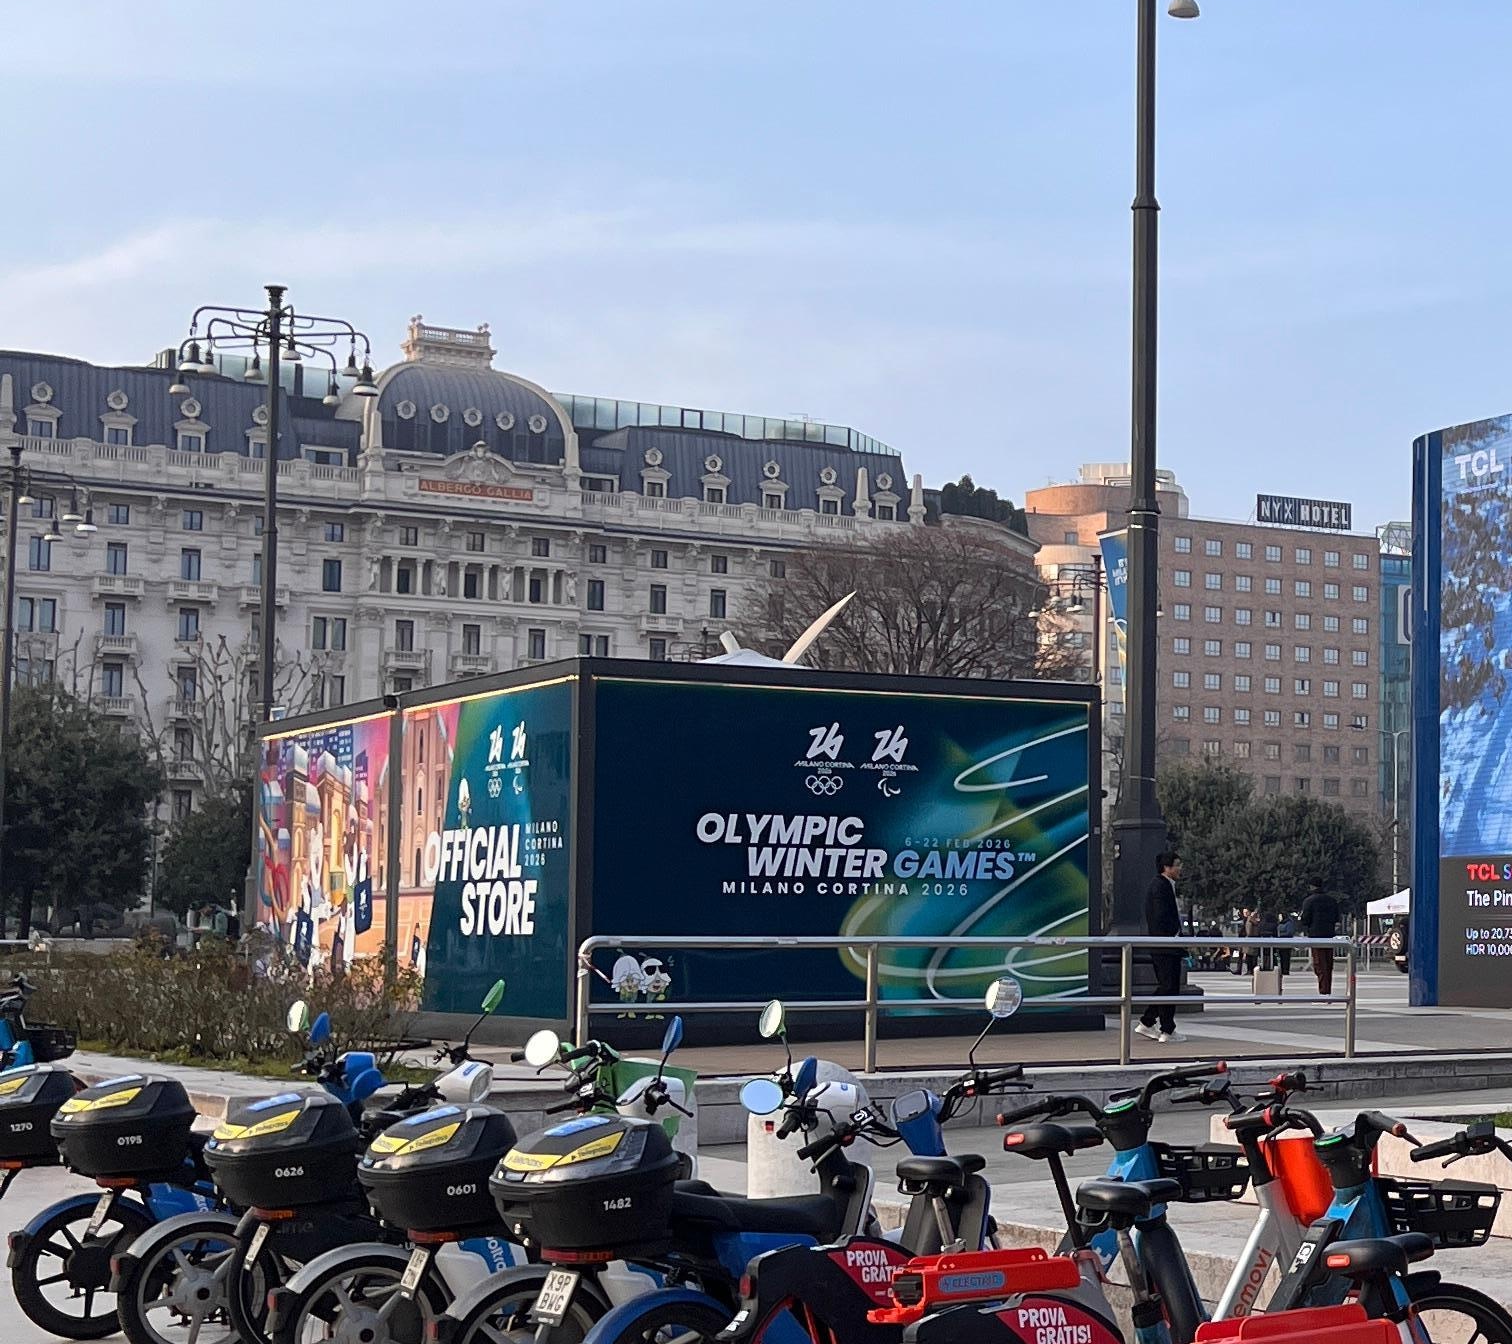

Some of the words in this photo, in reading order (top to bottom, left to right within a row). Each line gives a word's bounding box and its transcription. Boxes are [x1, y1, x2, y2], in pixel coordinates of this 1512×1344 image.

[1455, 448, 1504, 480] TCL
[421, 479, 481, 495] ALBERGO
[486, 486, 532, 500] GALLIA
[1261, 500, 1293, 520] NYX
[1300, 504, 1349, 525] HOTEL
[525, 820, 558, 835] MILANO
[696, 813, 864, 846] OLYMPIC
[524, 836, 563, 851] CORTINA
[904, 837, 938, 848] 6-22
[946, 838, 973, 849] FEB
[977, 838, 1011, 850] 2026
[424, 824, 522, 883] OFFICIAL
[747, 847, 888, 878] WINTER
[1466, 864, 1500, 881] TCL
[722, 881, 804, 895] MILANO
[817, 882, 909, 896] CORTINA
[921, 883, 968, 897] 2026
[1466, 890, 1490, 906] The
[460, 879, 538, 936] STORE
[1465, 928, 1479, 941] Up
[1480, 928, 1489, 939] to
[1465, 944, 1485, 955] HDR
[10, 1122, 33, 1133] 1270
[117, 1135, 142, 1146] 0195
[274, 1166, 304, 1178] 0626
[446, 1184, 477, 1196] 0601
[603, 1197, 632, 1211] 1482
[846, 1250, 888, 1267] PROVA
[1018, 1307, 1067, 1328] PROVA
